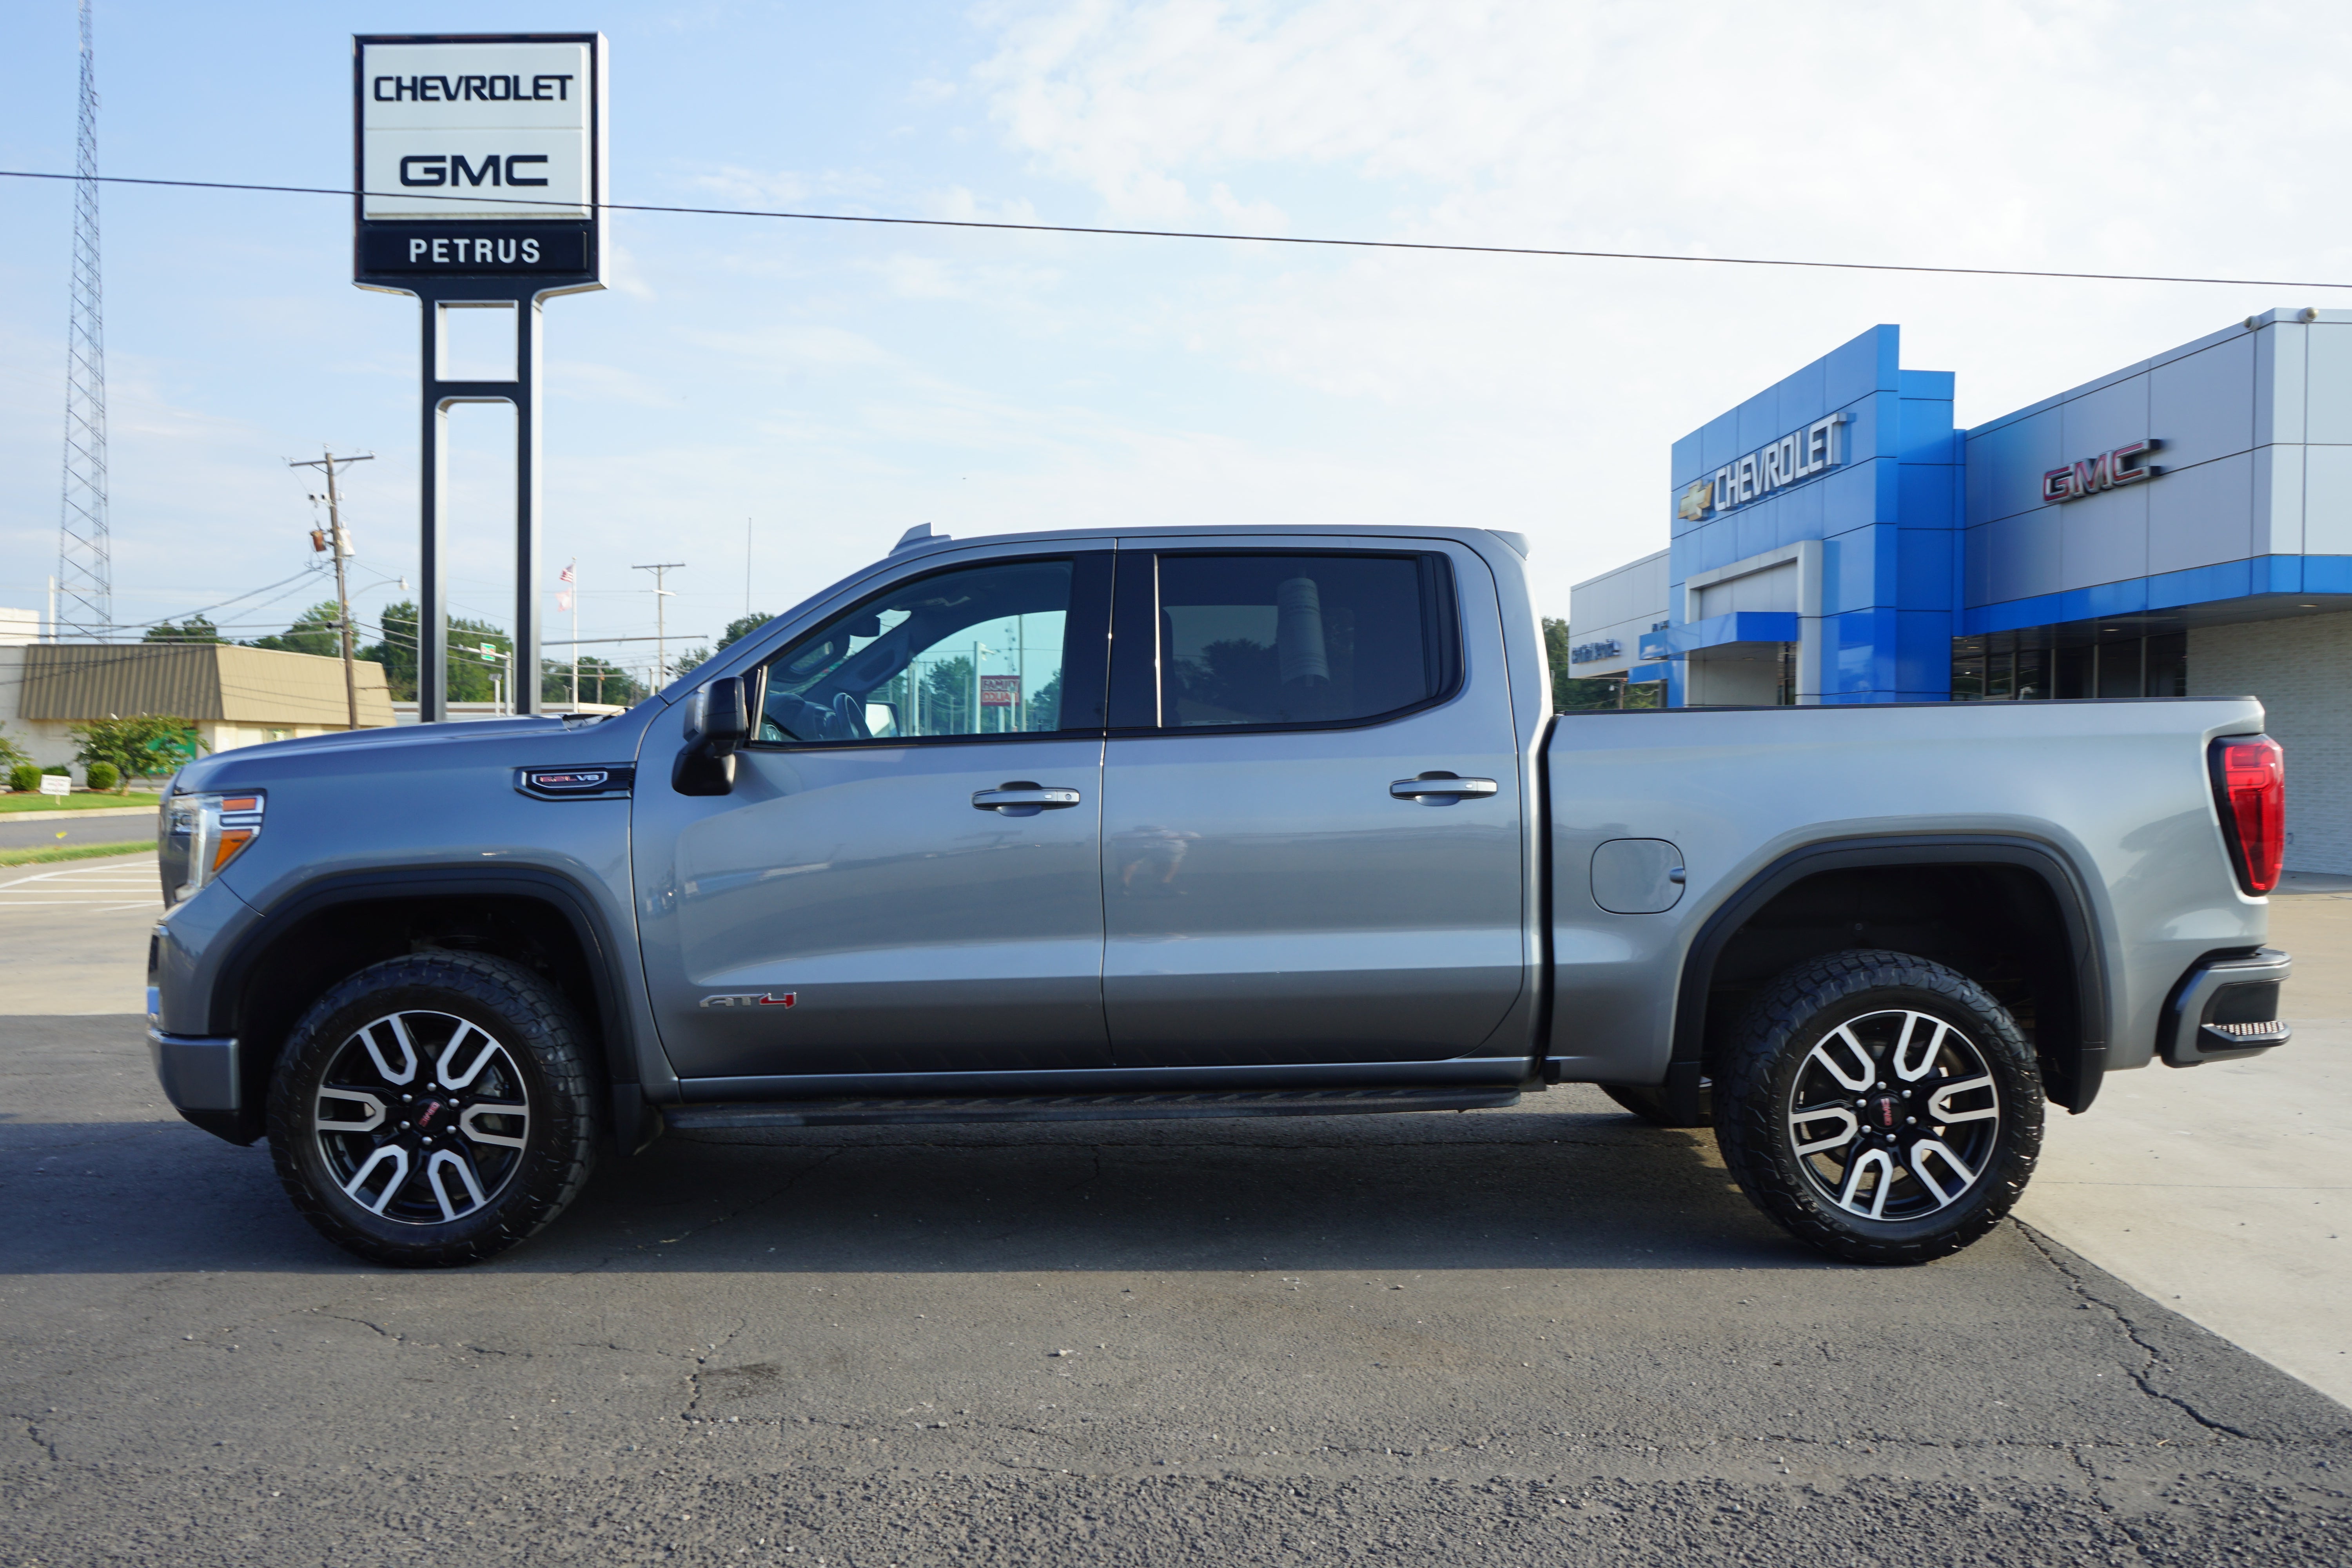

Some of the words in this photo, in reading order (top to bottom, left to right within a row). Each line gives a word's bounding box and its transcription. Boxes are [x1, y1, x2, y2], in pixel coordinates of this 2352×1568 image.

[374, 75, 573, 101] CHEVROLET
[400, 155, 548, 186] GMC
[410, 238, 540, 263] PETRUS
[1715, 413, 1847, 511] CHEVROLET
[2043, 438, 2159, 505] GMC
[699, 992, 797, 1010] AT4
[418, 1102, 440, 1127] GMC
[1880, 1098, 1892, 1126] GMC
